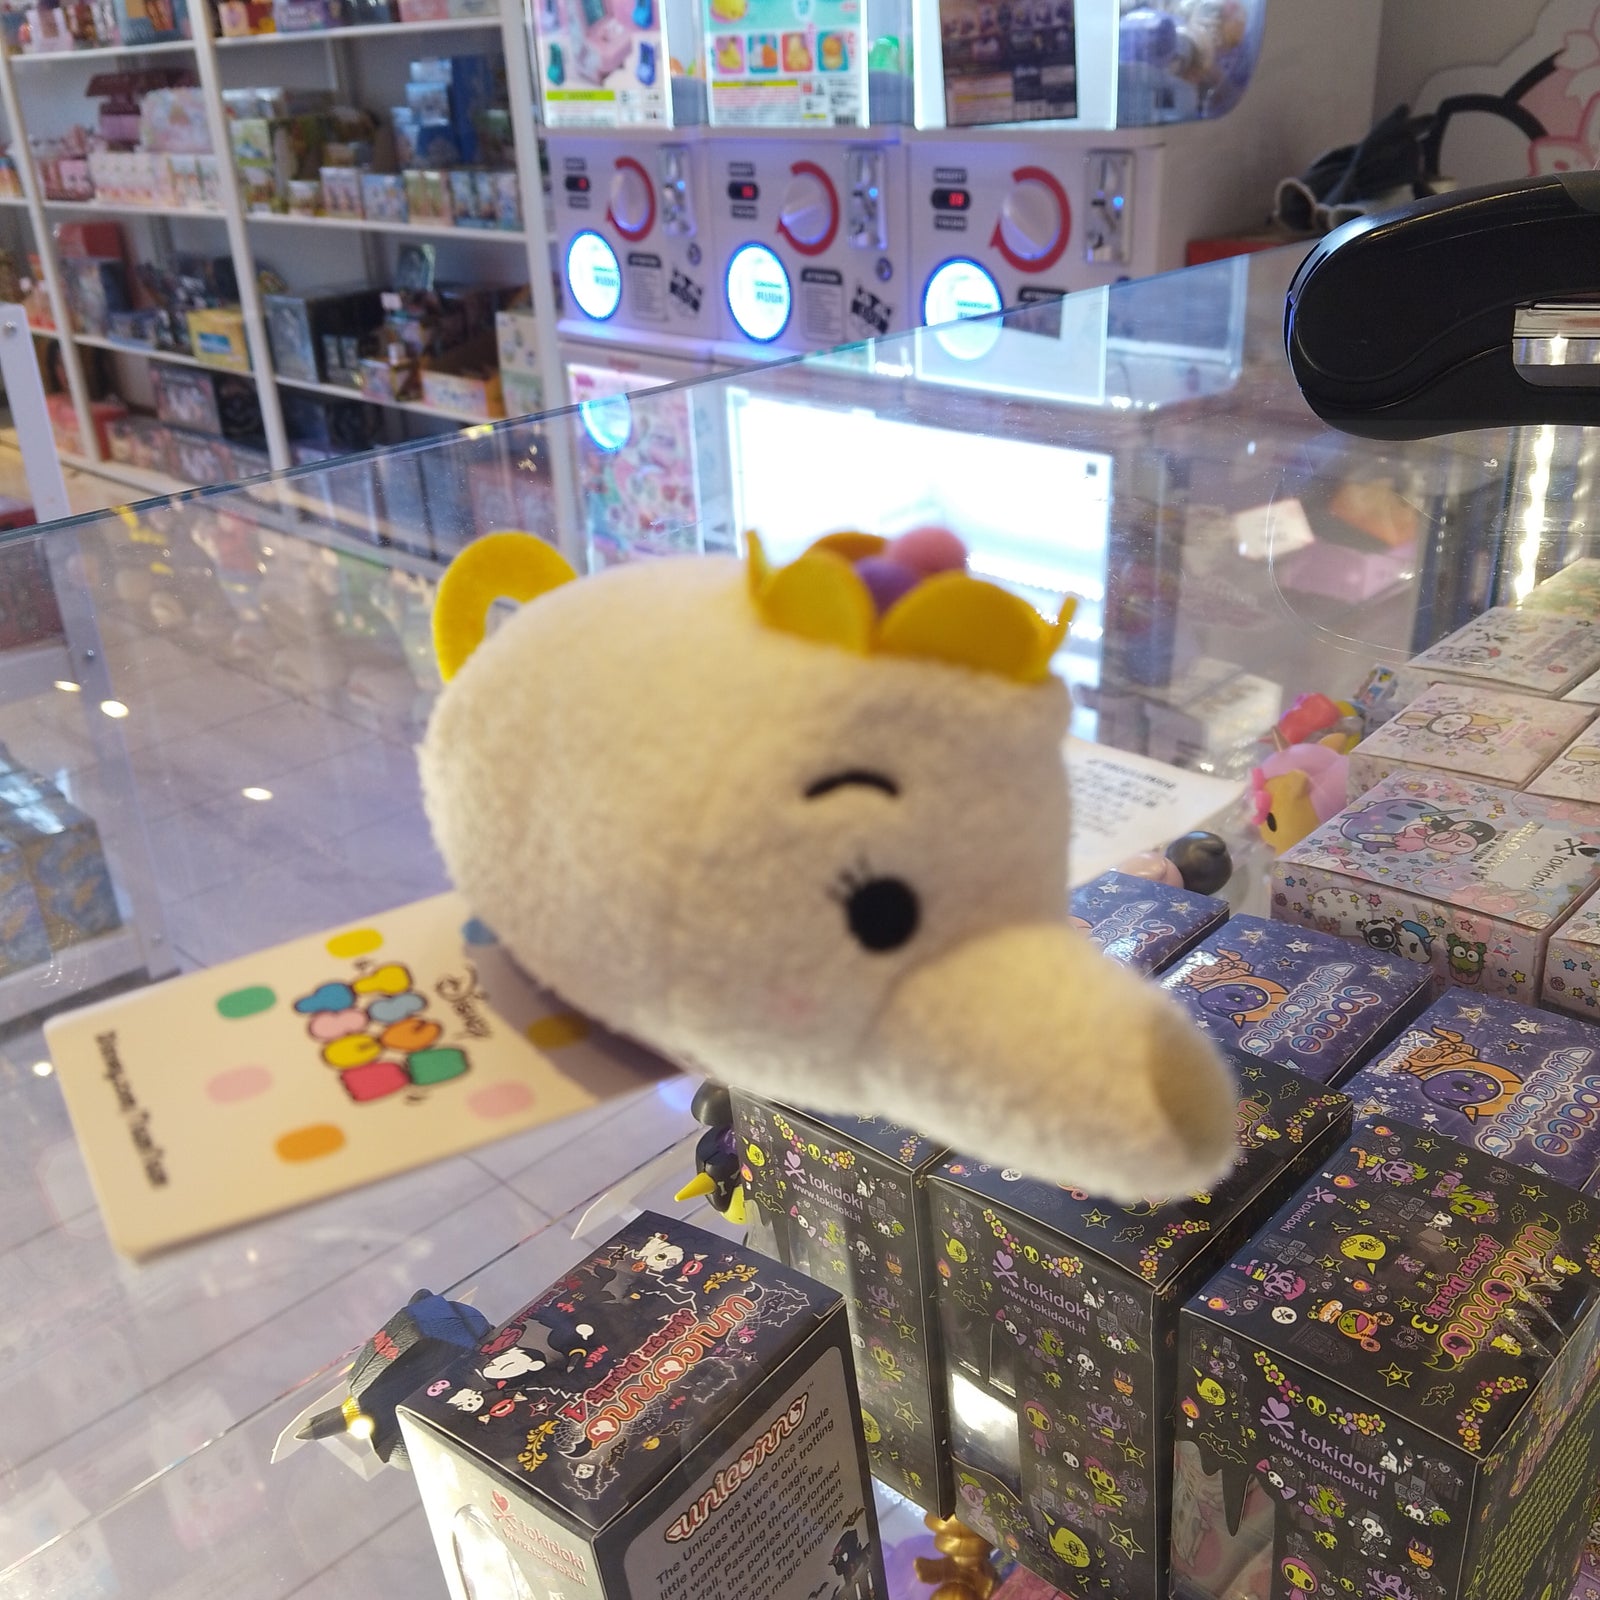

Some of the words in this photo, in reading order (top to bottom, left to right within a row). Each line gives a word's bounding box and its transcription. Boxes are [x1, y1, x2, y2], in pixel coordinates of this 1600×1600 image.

[1529, 856, 1569, 891] tokidoki
[436, 963, 493, 1039] Disney
[1290, 985, 1382, 1055] Space
[792, 1182, 862, 1223] www.tokidoki.it
[809, 1173, 864, 1210] tokidoki
[1280, 1201, 1316, 1233] tokidoki
[1458, 1234, 1504, 1279] After
[1001, 1285, 1086, 1335] www.tokidoki.it
[1022, 1276, 1091, 1321] tokidoki
[1420, 1273, 1475, 1320] Dark
[637, 1308, 698, 1358] After
[1411, 1314, 1439, 1334] 3
[583, 1354, 652, 1405] Dark
[555, 1400, 588, 1424] 4
[1269, 1433, 1378, 1500] www.tokidoki.it
[1300, 1428, 1386, 1486] tokidoki
[656, 1562, 680, 1584] The
[683, 1501, 741, 1561] Unicornos
[743, 1471, 769, 1501] were
[771, 1444, 796, 1471] once
[797, 1407, 829, 1444] simple
[660, 1574, 687, 1600] little
[690, 1533, 728, 1576] ponies
[729, 1507, 752, 1533] that
[753, 1480, 779, 1508] were
[781, 1460, 798, 1480] out
[799, 1420, 834, 1459] trotting
[723, 1529, 766, 1576] Passing
[767, 1485, 807, 1530] through
[807, 1465, 824, 1486] the
[520, 1519, 587, 1572] tokidoki
[690, 1530, 745, 1592] wandered
[747, 1510, 767, 1534] into
[769, 1501, 776, 1511] a
[778, 1465, 808, 1502] magic
[727, 1570, 745, 1590] the
[747, 1530, 781, 1573] ponies
[782, 1461, 841, 1531] transformed
[751, 1558, 770, 1584] and
[772, 1524, 800, 1560] found
[802, 1516, 809, 1527] a
[810, 1478, 842, 1518] hidden
[771, 1558, 801, 1595] magic
[803, 1509, 843, 1558] kingdom
[775, 1549, 795, 1572] The
[796, 1492, 844, 1549] Unicornos
